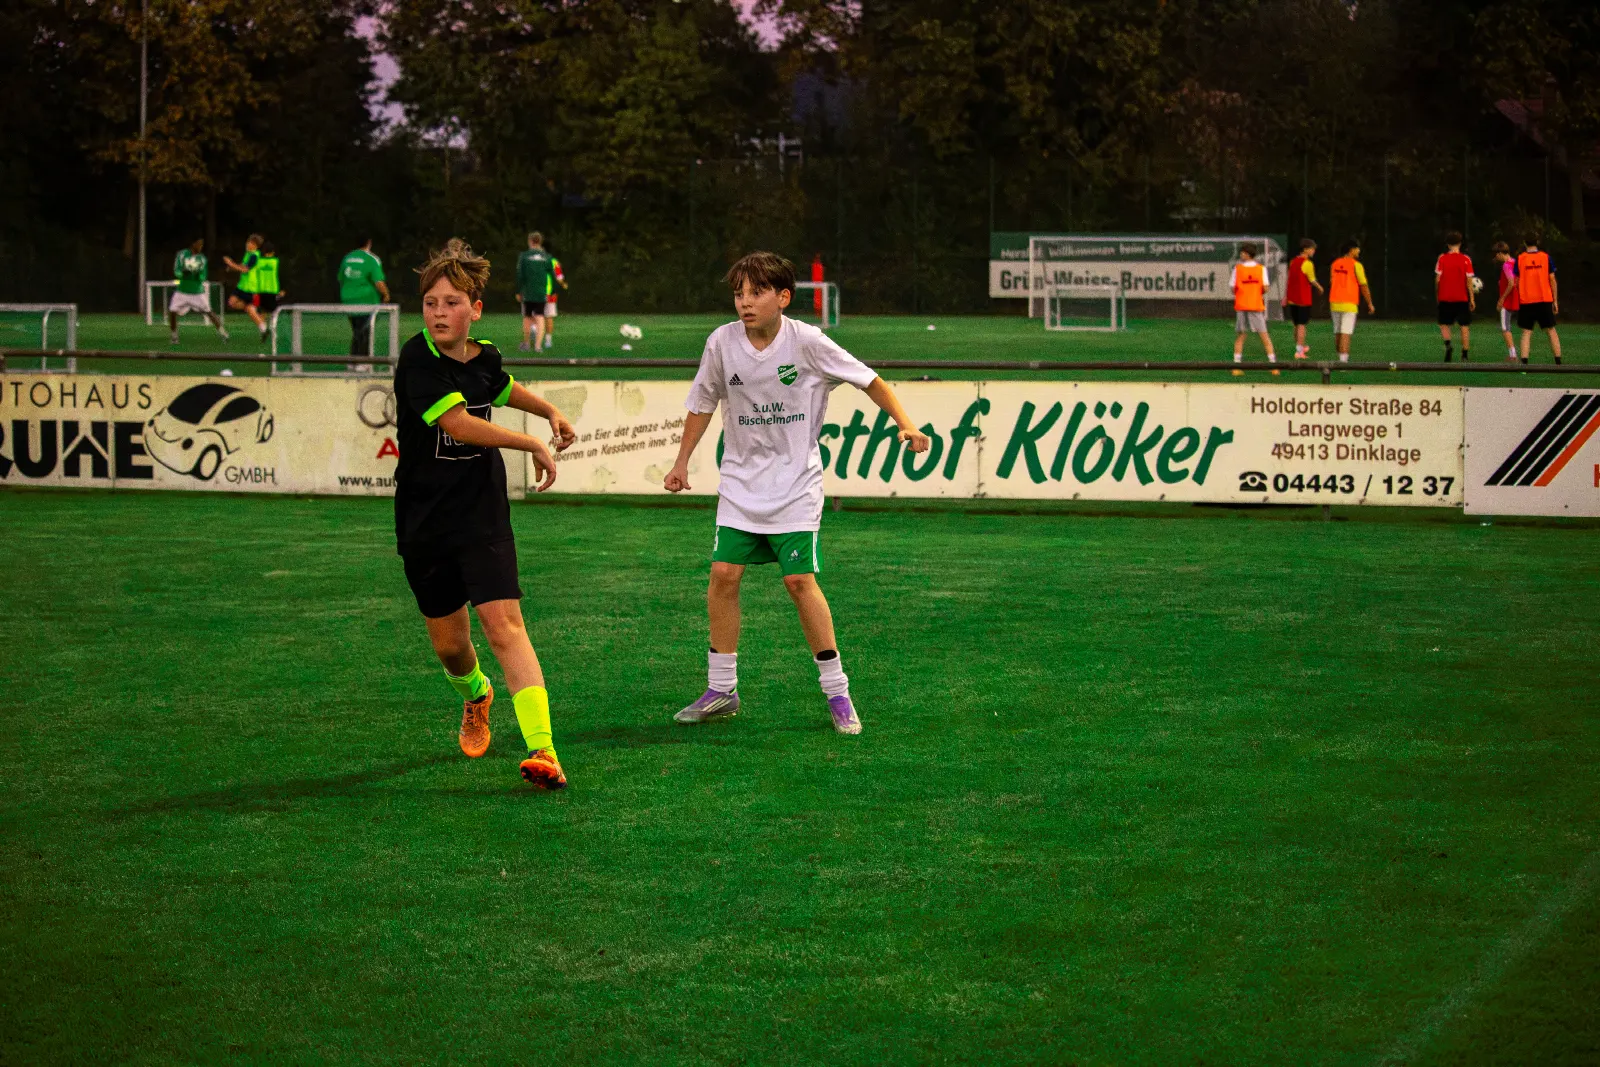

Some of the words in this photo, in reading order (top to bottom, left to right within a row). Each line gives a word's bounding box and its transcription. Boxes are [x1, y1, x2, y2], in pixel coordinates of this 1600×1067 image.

[0, 382, 152, 409] TOHAUS
[752, 401, 786, 413] S.u.W.
[1250, 396, 1343, 416] Holdorfer
[1349, 398, 1413, 416] Straße
[1419, 399, 1443, 416] 84
[738, 412, 806, 426] Büschelmann
[716, 396, 991, 483] sthof
[996, 399, 1235, 486] Klöker
[1287, 420, 1388, 443] Langwege
[1395, 422, 1403, 438] 1
[1271, 443, 1330, 461] 49413
[1336, 443, 1422, 466] Dinklage
[224, 466, 276, 484] GMBH
[1272, 473, 1356, 495] 04443
[1382, 476, 1414, 496] 12
[1422, 476, 1456, 497] 37
